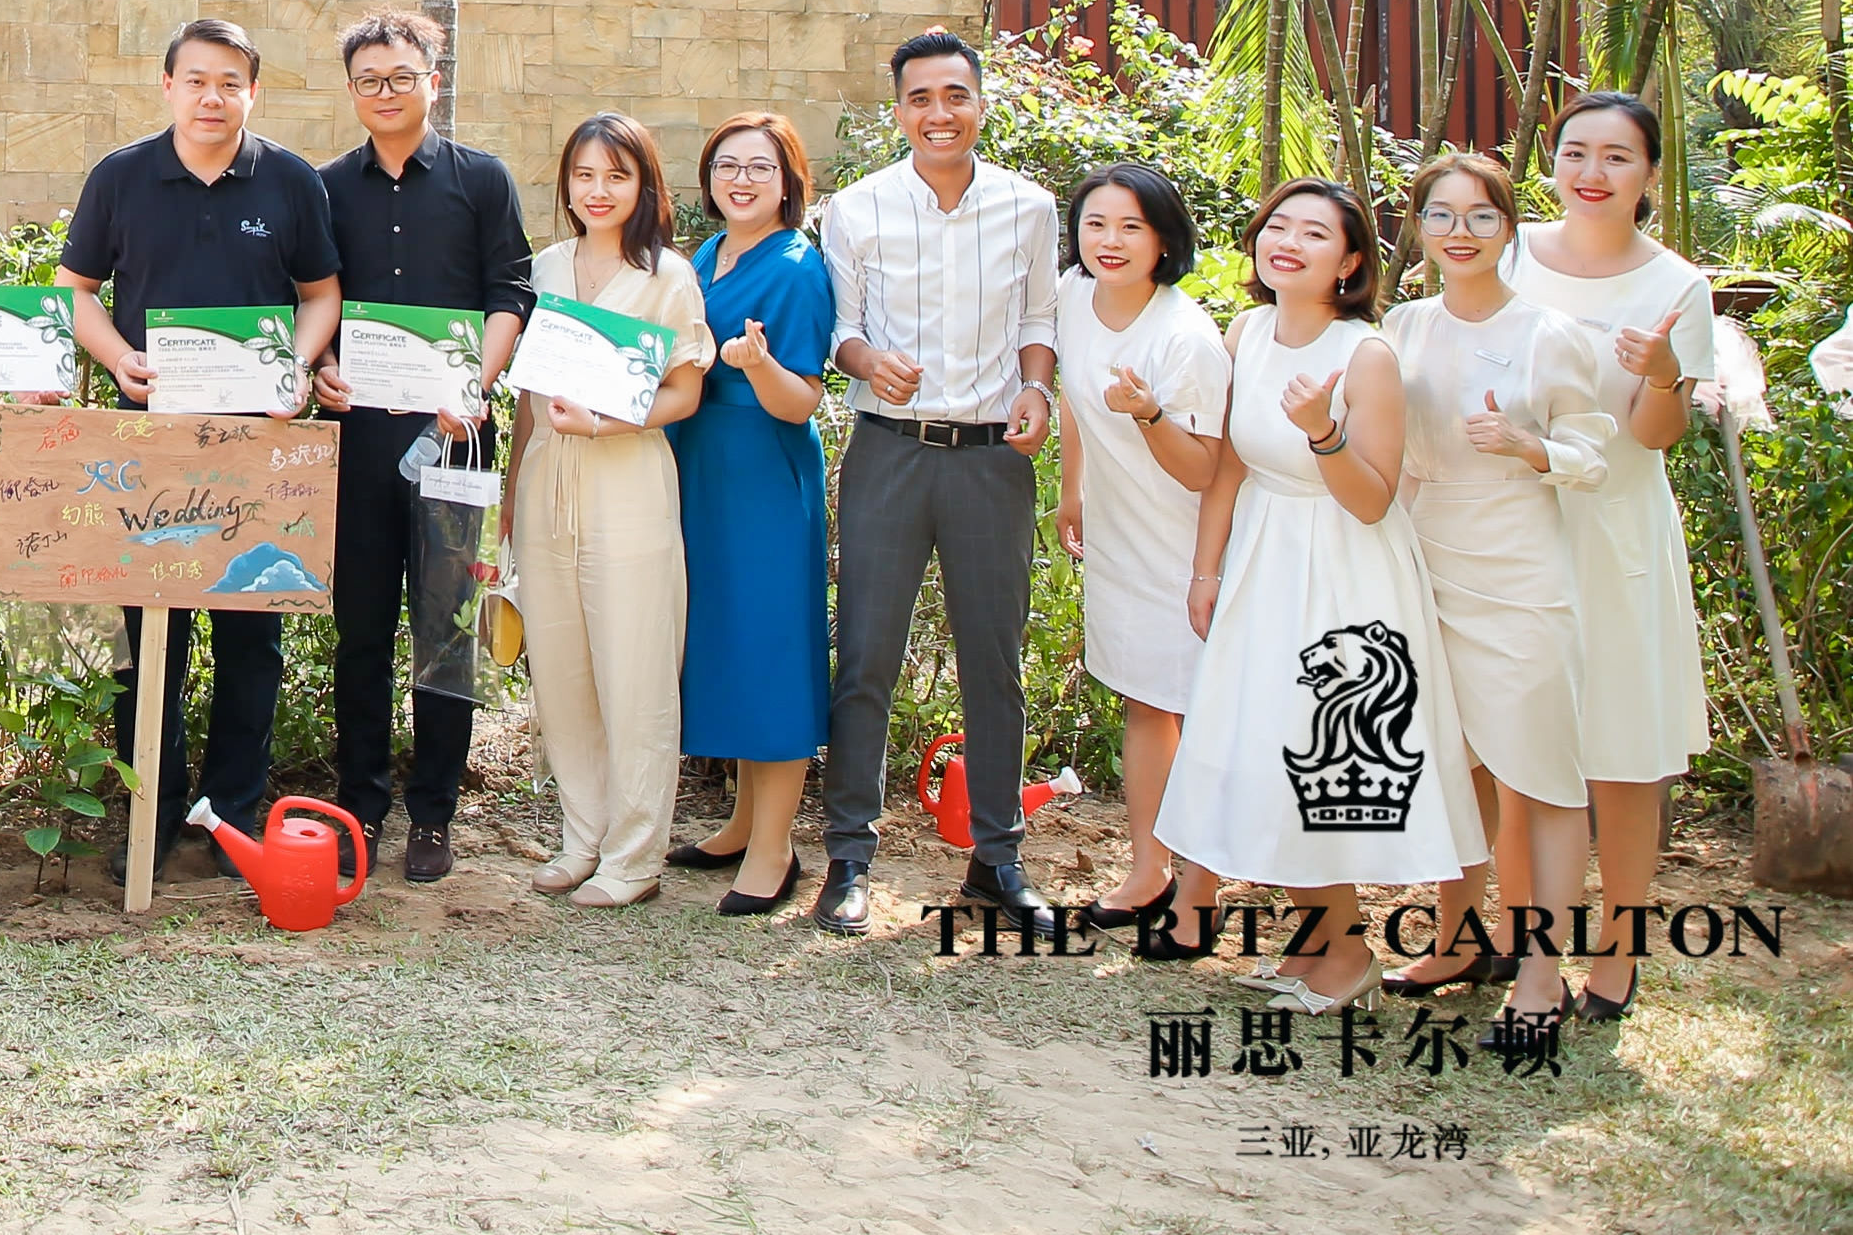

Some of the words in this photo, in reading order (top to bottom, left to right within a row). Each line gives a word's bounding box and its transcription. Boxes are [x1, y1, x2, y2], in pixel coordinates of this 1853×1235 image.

[158, 337, 217, 346] CERTIFICATE
[351, 329, 407, 342] CERTIFICATE
[117, 487, 243, 541] Wedding
